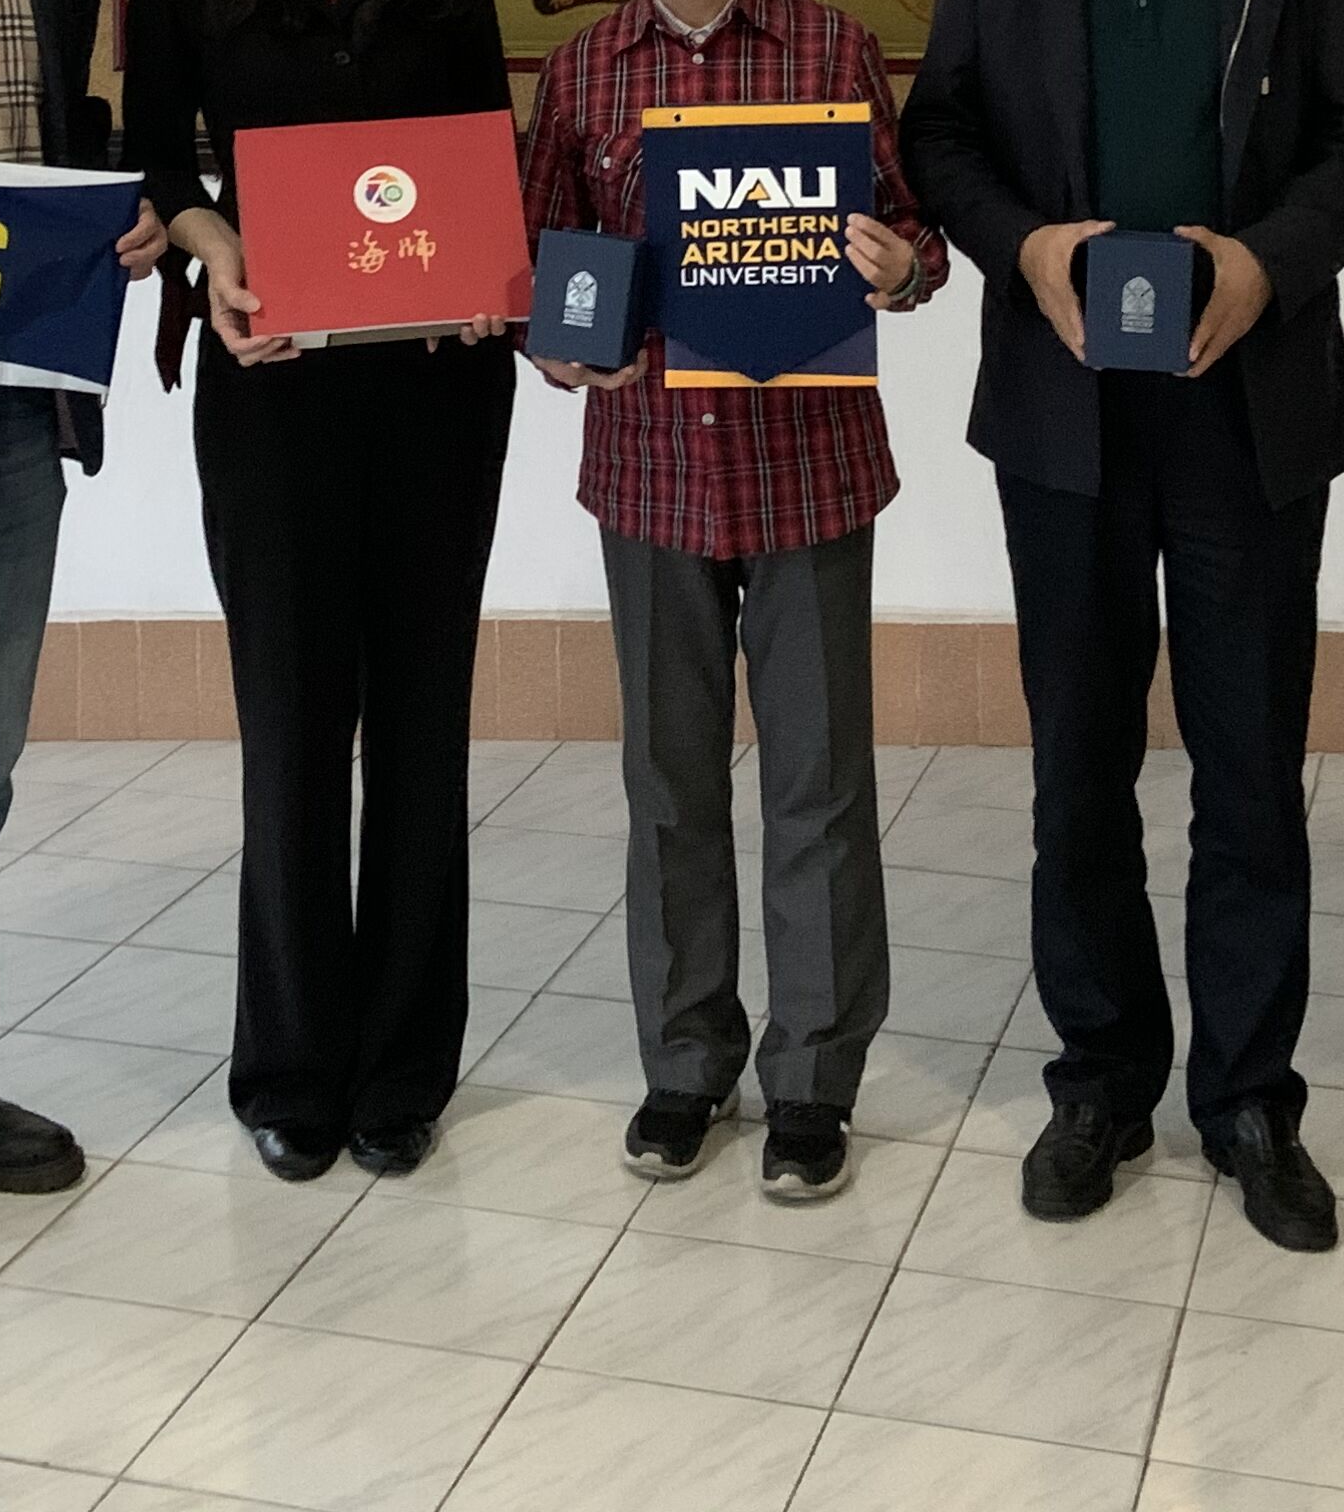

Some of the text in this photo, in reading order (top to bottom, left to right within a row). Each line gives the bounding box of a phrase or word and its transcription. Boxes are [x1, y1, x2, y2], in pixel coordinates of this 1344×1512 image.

[677, 167, 837, 210] NAU
[681, 215, 839, 239] NORTHERN
[681, 237, 841, 266] ARIZONA
[680, 265, 839, 287] UNIVERSITY
